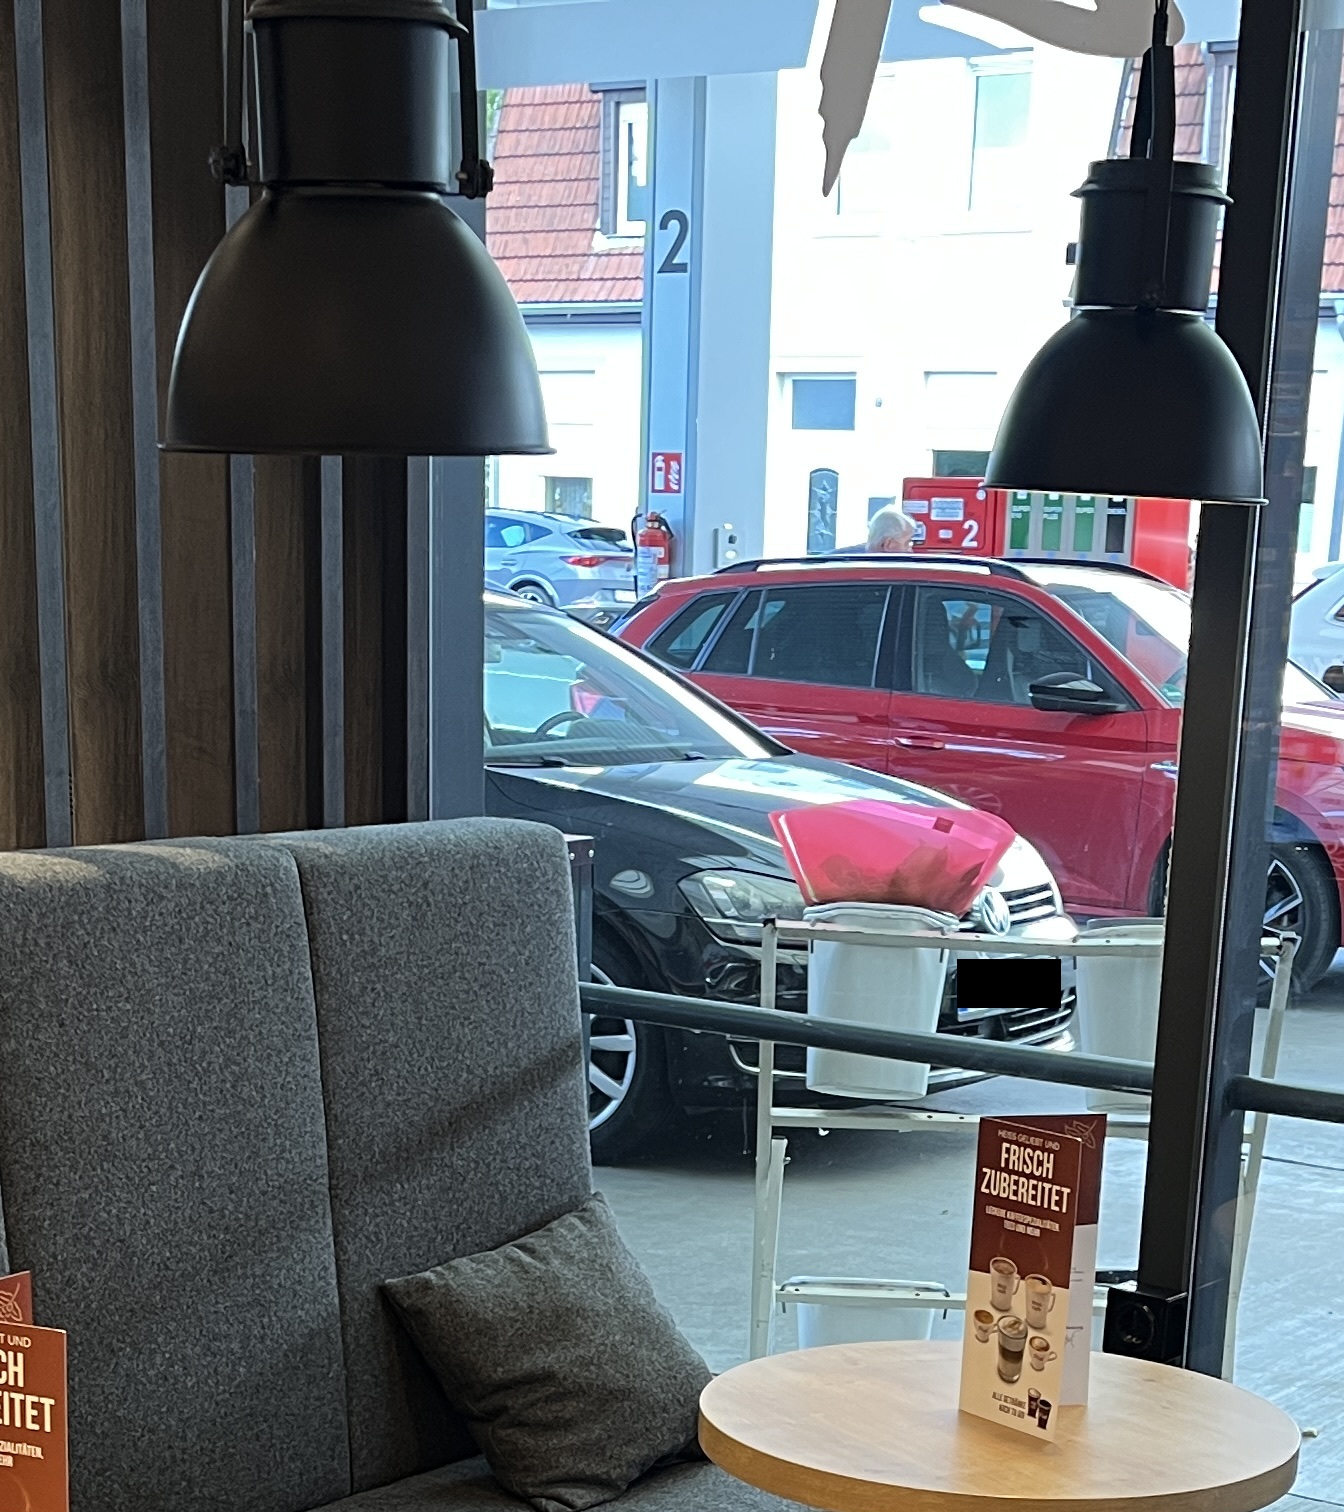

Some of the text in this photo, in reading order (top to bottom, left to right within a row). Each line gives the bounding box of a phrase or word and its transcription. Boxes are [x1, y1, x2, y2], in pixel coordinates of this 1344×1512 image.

[657, 209, 688, 274] 2
[961, 519, 979, 547] 2
[1000, 1142, 1054, 1179] FRISCH
[980, 1167, 1071, 1213] ZUBEREITET
[7, 1335, 31, 1348] UND
